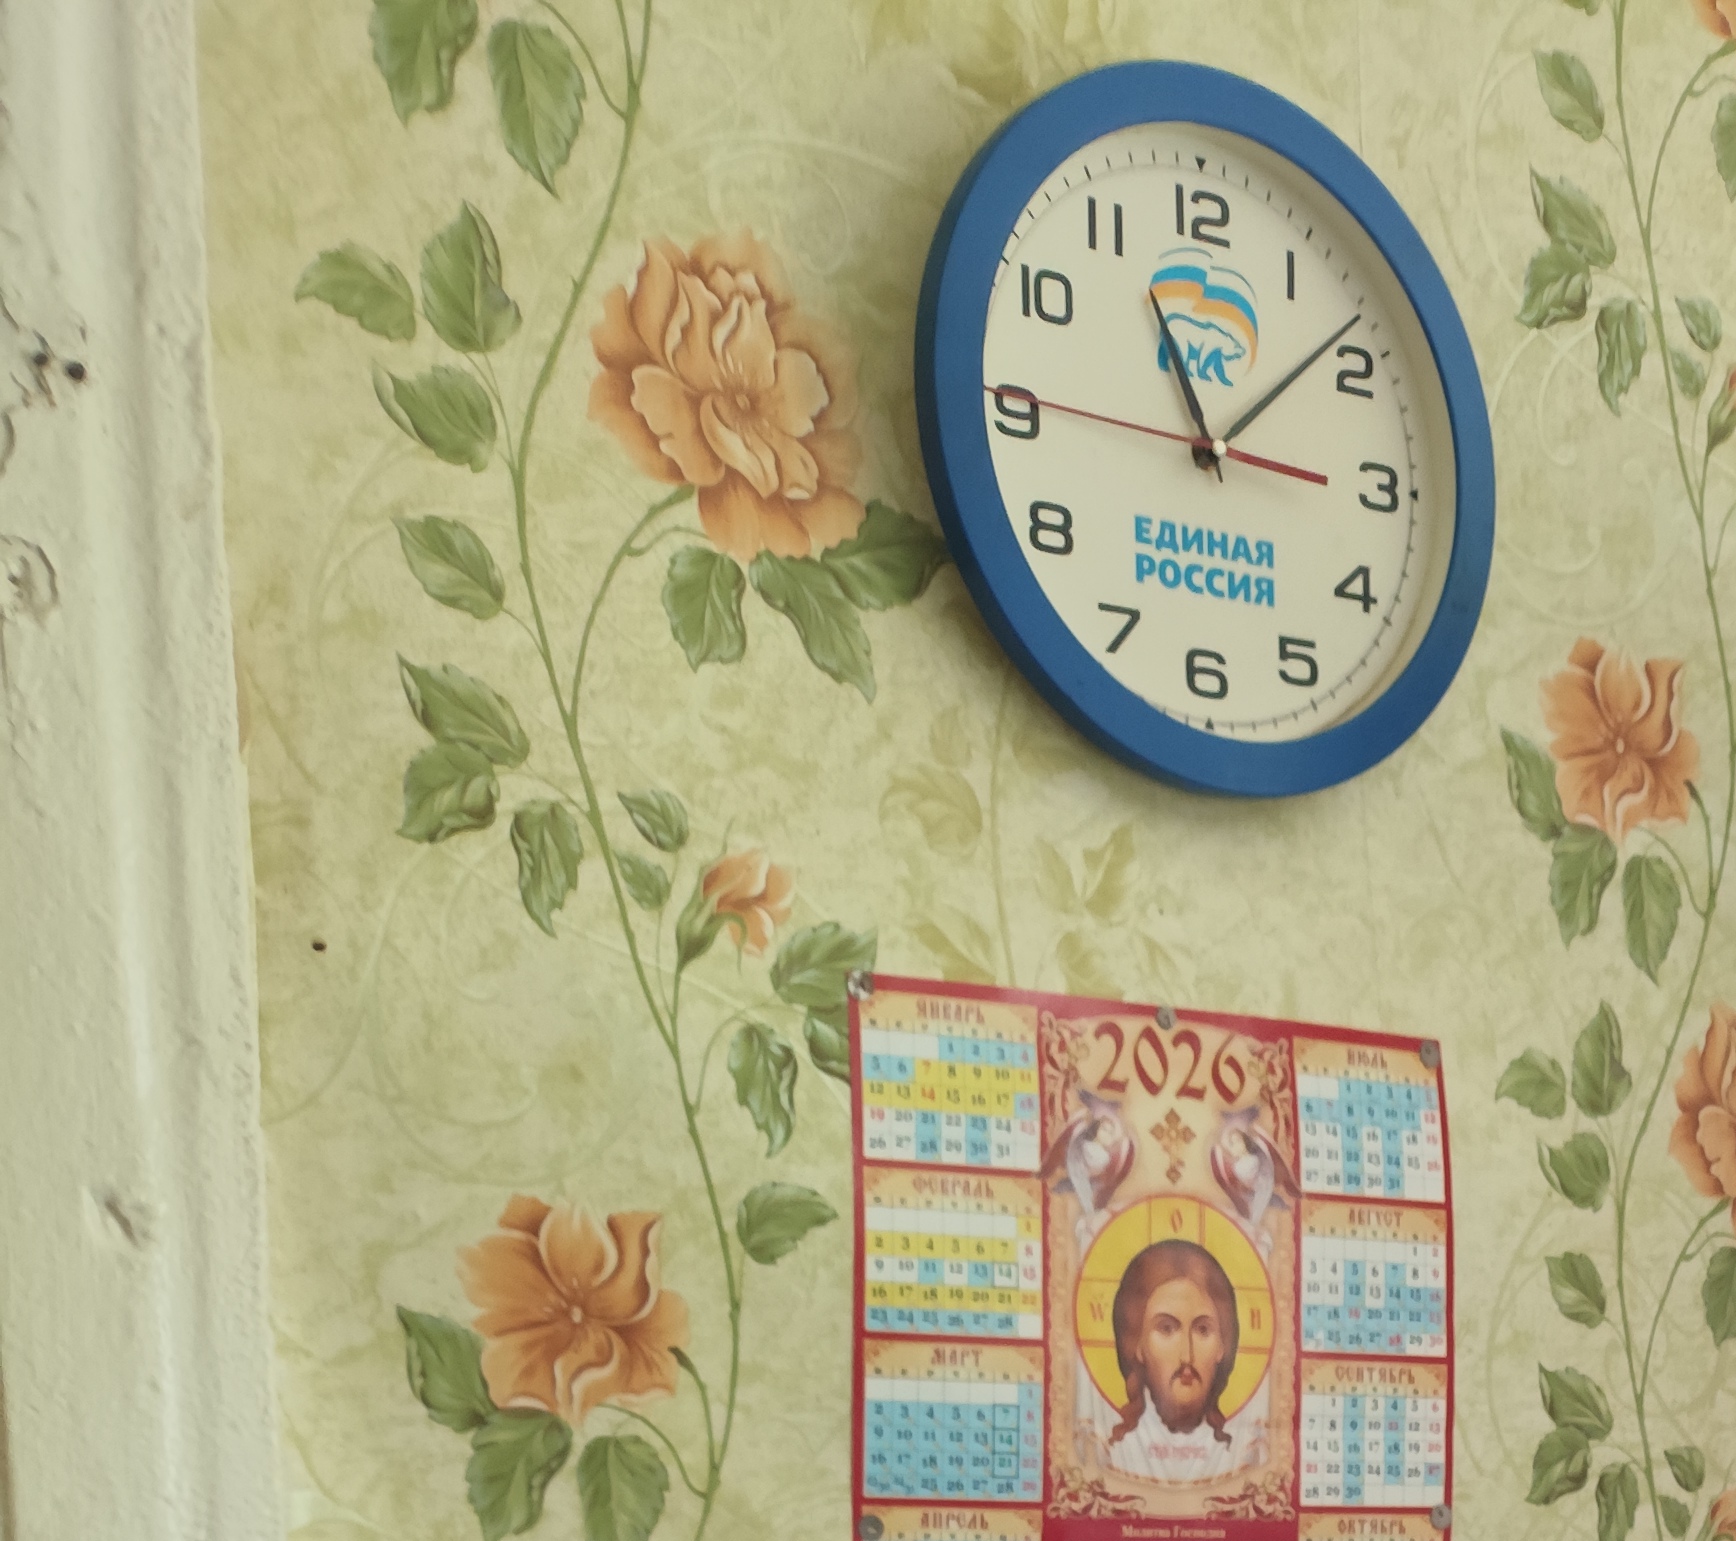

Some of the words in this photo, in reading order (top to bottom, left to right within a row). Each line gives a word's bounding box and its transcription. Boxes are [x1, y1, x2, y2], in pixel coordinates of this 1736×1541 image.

[1088, 196, 1124, 256] 11
[1176, 184, 1231, 247] 12
[1020, 265, 1073, 326] 10
[1285, 250, 1296, 300] 1
[1337, 346, 1374, 399] 2
[995, 385, 1041, 440] 9
[1358, 463, 1399, 513] 3
[1030, 501, 1074, 555] 8
[1133, 515, 1275, 569] ЕДИНАЯ
[1136, 553, 1275, 607] РОССИЯ
[1334, 566, 1378, 613] 4
[1099, 602, 1141, 654] 7
[1185, 649, 1229, 700] 6
[1278, 636, 1319, 687] 5
[1095, 1021, 1246, 1104] 2026
[921, 1513, 988, 1529] АПРЕЛЬ
[1338, 1519, 1405, 1534] ОКТЯБРЬ
